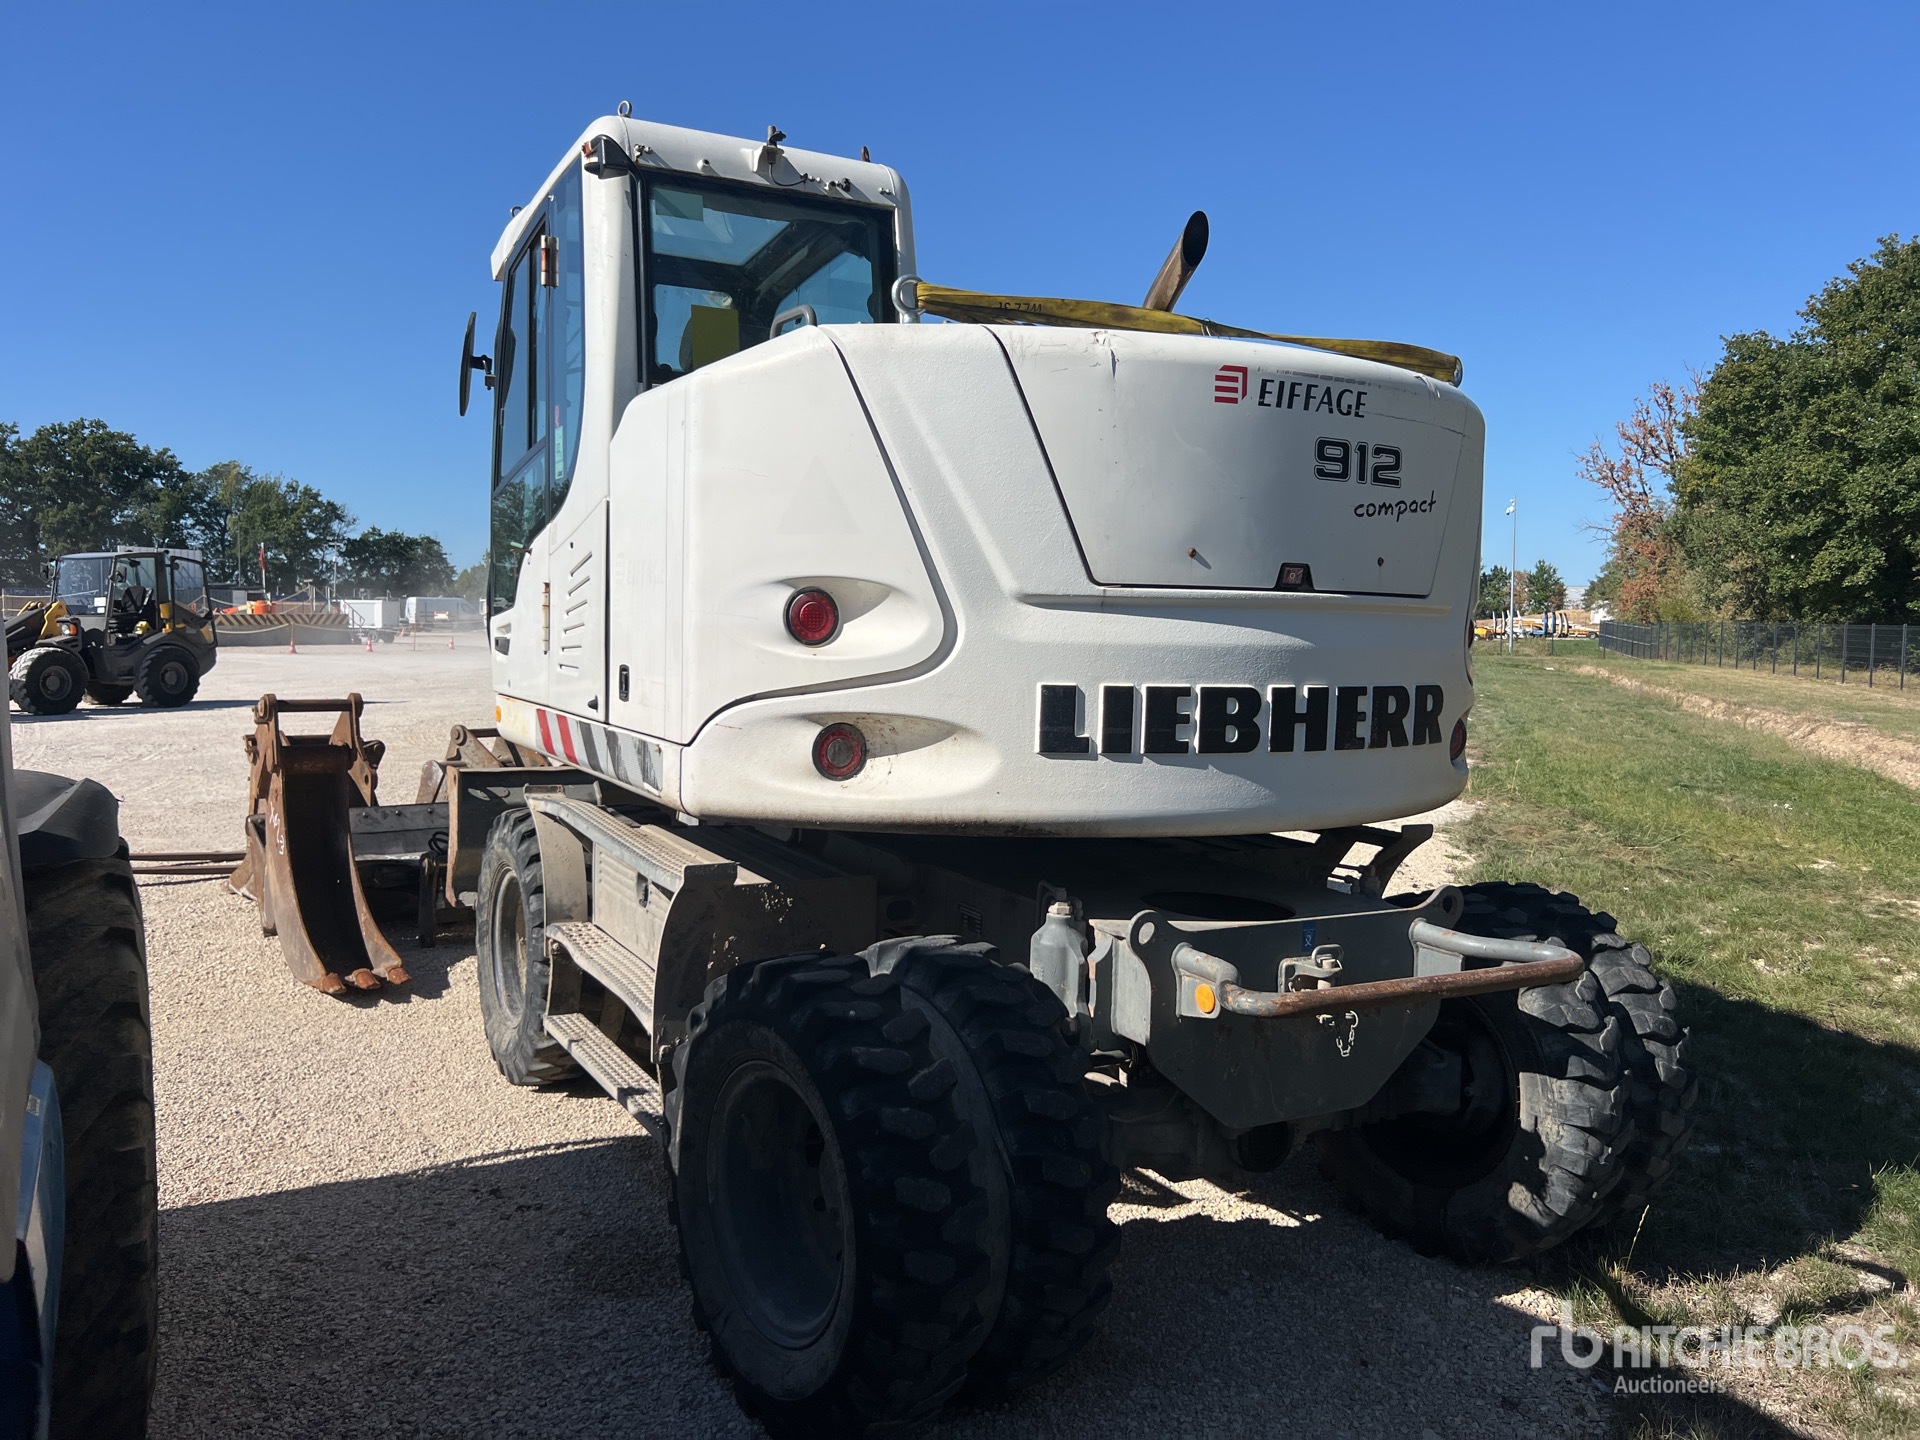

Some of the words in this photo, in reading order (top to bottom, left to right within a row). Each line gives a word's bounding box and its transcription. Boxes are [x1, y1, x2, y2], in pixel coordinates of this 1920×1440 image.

[1257, 378, 1368, 418] EIFFAGE
[1314, 437, 1402, 488] 912
[1353, 490, 1437, 522] compact
[1036, 683, 1444, 755] LIEBHERR
